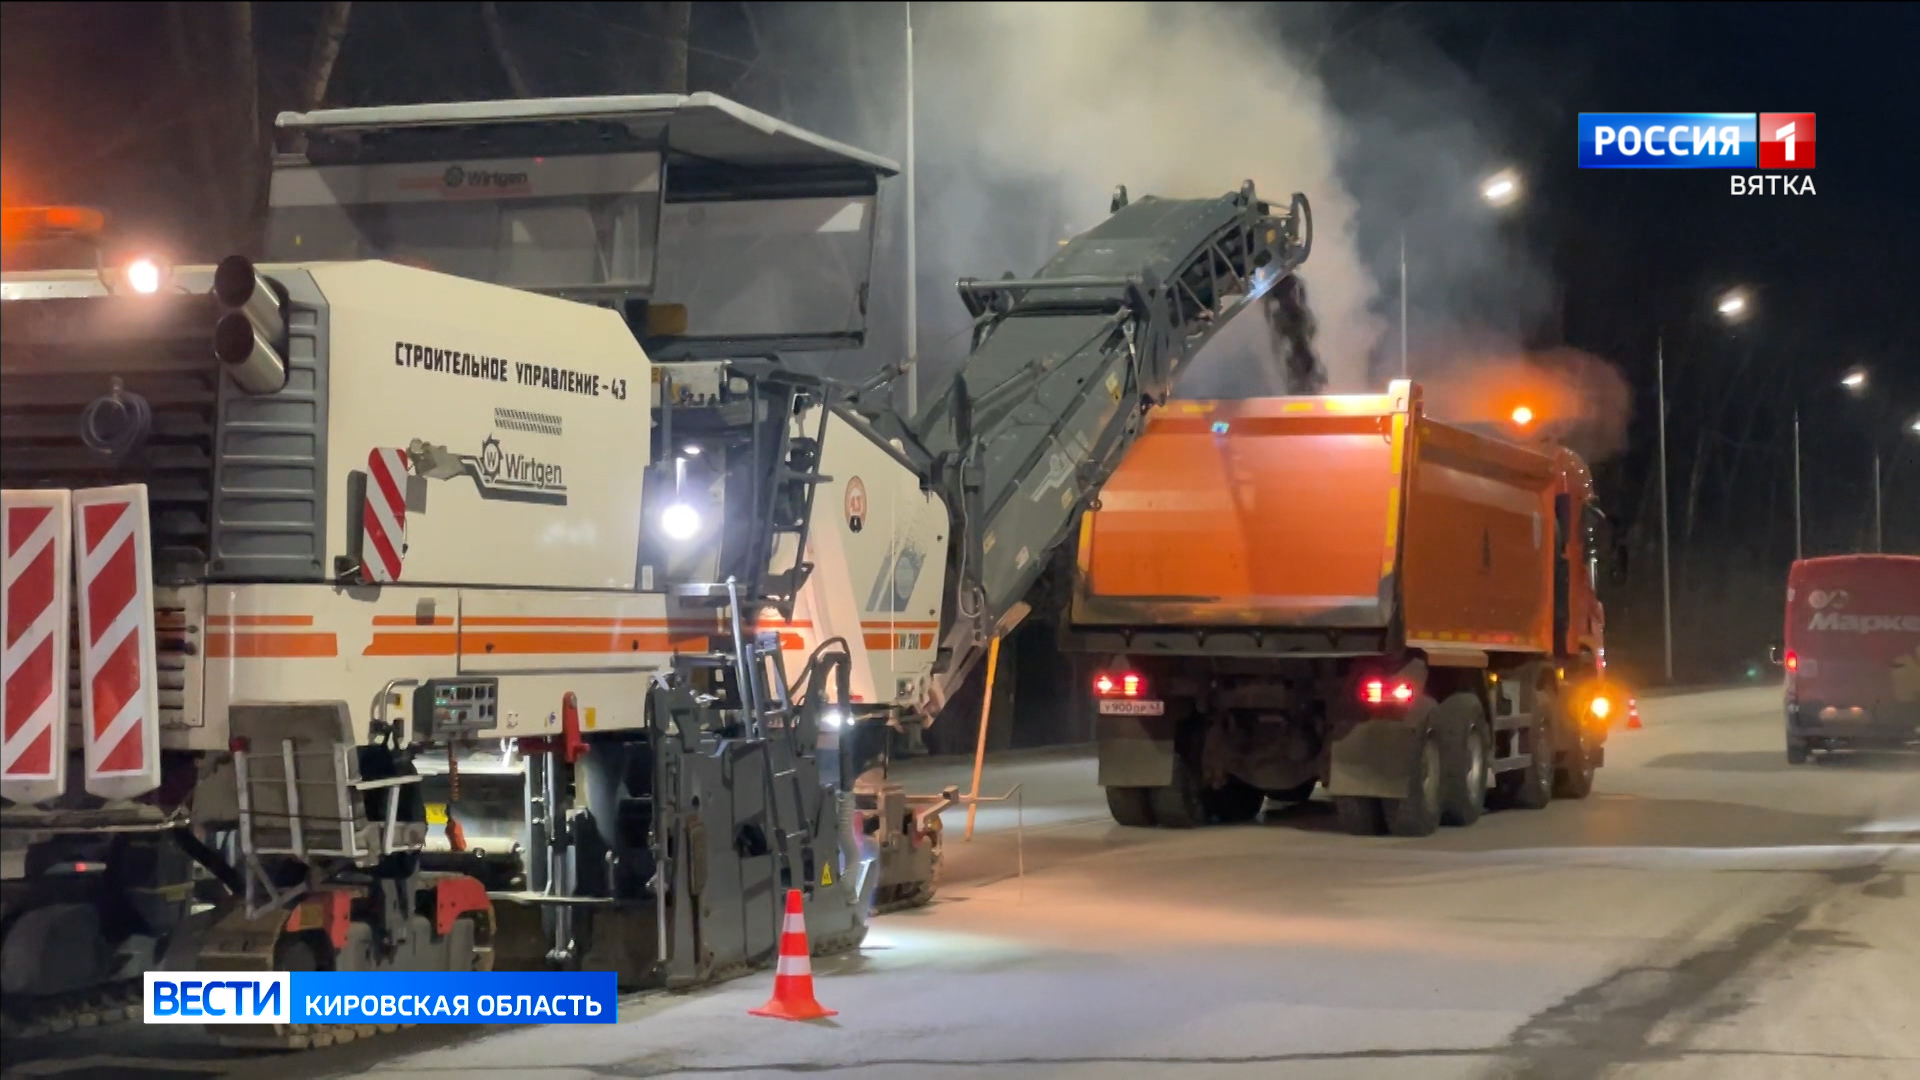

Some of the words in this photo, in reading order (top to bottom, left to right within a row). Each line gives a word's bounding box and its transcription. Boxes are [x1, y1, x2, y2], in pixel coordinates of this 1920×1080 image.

[467, 170, 528, 187] Wirtgen
[395, 341, 508, 382] СТРОИТЕЛЬНОЕ
[505, 453, 563, 489] Wirtgen
